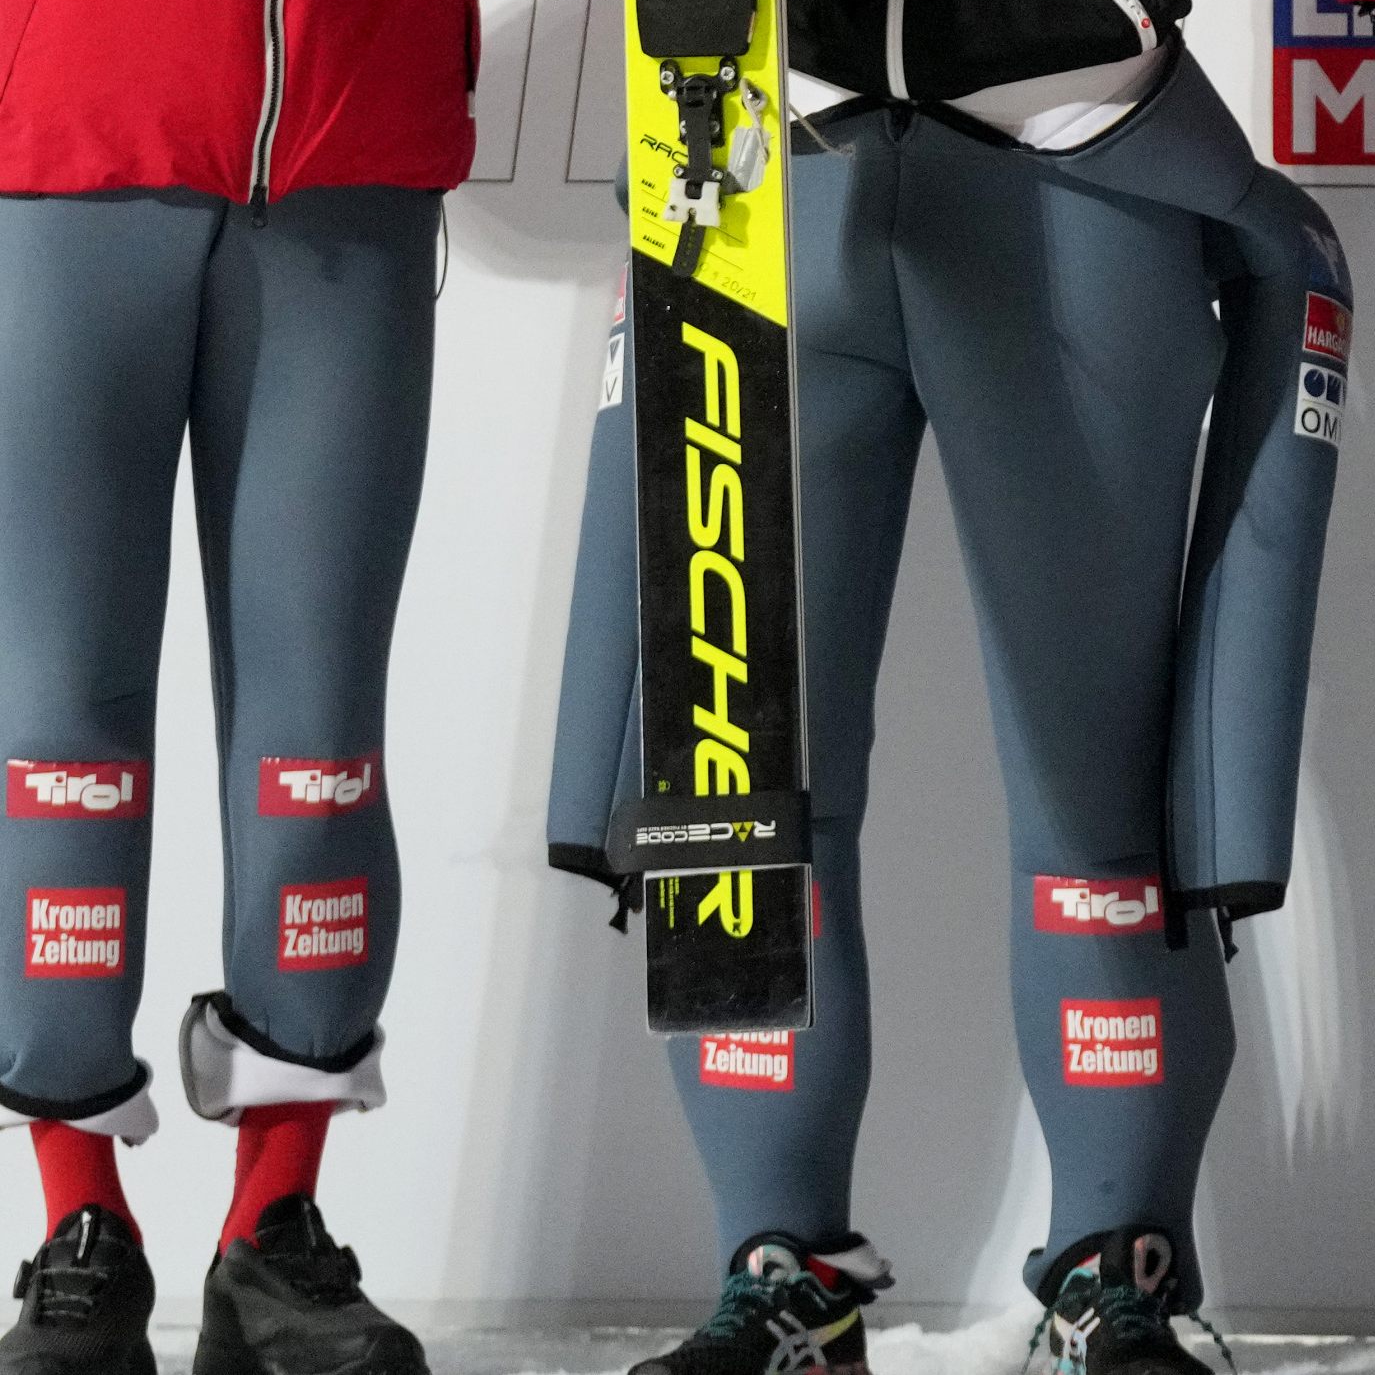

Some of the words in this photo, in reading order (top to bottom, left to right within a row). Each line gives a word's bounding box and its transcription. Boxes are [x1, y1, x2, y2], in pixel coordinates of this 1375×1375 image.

[682, 322, 754, 939] FISCHER
[25, 770, 134, 811] Tirol
[278, 763, 372, 805] Tirol
[32, 899, 121, 931] Kronen
[285, 892, 364, 925] Kronen
[1052, 885, 1159, 926] Tirol
[30, 934, 120, 968] Zeitung
[284, 925, 364, 958] Zeitung
[1067, 1009, 1156, 1041] Kronen
[704, 1041, 789, 1081] Zeitung
[1068, 1043, 1158, 1076] Zeitung
